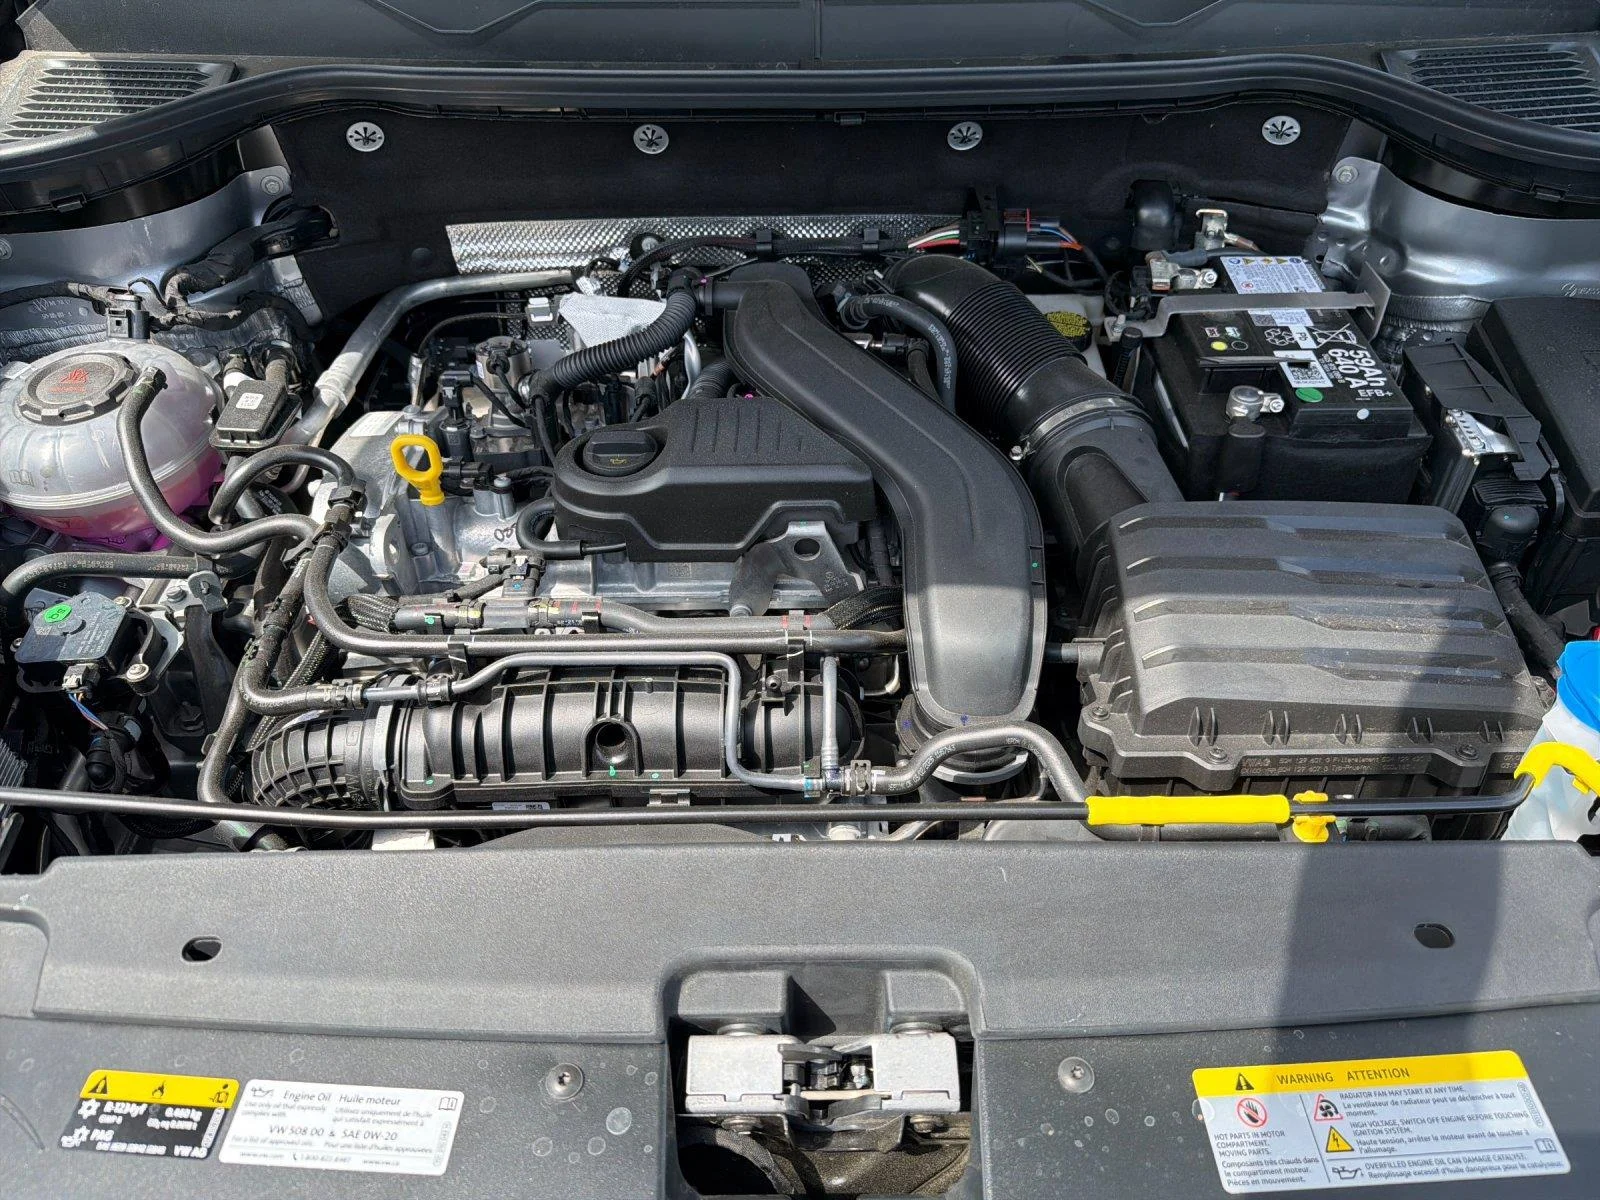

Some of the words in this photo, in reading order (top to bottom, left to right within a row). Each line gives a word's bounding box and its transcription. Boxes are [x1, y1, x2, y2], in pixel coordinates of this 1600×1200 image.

[1328, 348, 1360, 374] 640
[1344, 376, 1369, 388] A
[1349, 350, 1387, 386] 59Ah
[1358, 389, 1393, 397] EFB+
[1276, 1072, 1334, 1085] WARNING
[1346, 1068, 1410, 1081] ATTENTION
[283, 1090, 316, 1102] Engine
[317, 1092, 332, 1101] Oil
[339, 1093, 364, 1103] Huile
[366, 1095, 401, 1106] moteur
[1339, 1091, 1373, 1100] RADIATOR
[1373, 1090, 1387, 1098] FAN
[1388, 1089, 1402, 1097] MAY
[1403, 1088, 1423, 1096] START
[1433, 1086, 1447, 1094] ANY
[1352, 1100, 1389, 1108] ventilateur
[1400, 1097, 1431, 1105] radiateur
[1432, 1096, 1448, 1105] peut
[1457, 1093, 1494, 1101] déclencher
[1346, 1109, 1377, 1117] moment.
[1350, 1120, 1367, 1129] HIGH
[1368, 1119, 1400, 1128] VOLTAGE,
[1401, 1117, 1426, 1125] SWITCH
[1427, 1116, 1440, 1124] OFF
[1441, 1114, 1467, 1122] ENGINE
[1467, 1113, 1494, 1121] BEFORE
[1494, 1111, 1529, 1119] TOUCHING
[269, 1124, 288, 1134] VW
[289, 1126, 308, 1136] 508
[310, 1127, 325, 1137] 00
[329, 1129, 336, 1137] &
[342, 1128, 363, 1140] SAE
[363, 1130, 399, 1141] 0W-20
[1214, 1133, 1228, 1141] HOT
[1229, 1132, 1250, 1140] PARTS
[1261, 1130, 1286, 1138] MOTOR
[1352, 1128, 1384, 1137] IGNITION
[1384, 1126, 1412, 1135] SYSTEM.
[1356, 1138, 1379, 1146] Haute
[1380, 1137, 1407, 1145] tension,
[1407, 1135, 1431, 1143] arrêter
[1439, 1133, 1465, 1141] moteur
[1466, 1131, 1485, 1139] avant
[1487, 1130, 1496, 1138] de
[1496, 1129, 1525, 1137] toucher
[1216, 1140, 1270, 1149] COMPARTMENT.
[1219, 1149, 1247, 1157] MOVING
[1248, 1148, 1271, 1156] PARTS.
[1222, 1160, 1264, 1169] Composants
[1264, 1158, 1278, 1166] très
[1278, 1156, 1302, 1164] chauds
[1303, 1156, 1320, 1164] dans
[1364, 1160, 1407, 1170] OVERFILLED
[1407, 1158, 1434, 1167] ENGINE
[1435, 1157, 1446, 1165] OIL
[1447, 1157, 1461, 1165] CAN
[1463, 1155, 1491, 1164] DAMAGE
[1232, 1168, 1283, 1178] compartiment
[1283, 1166, 1310, 1175] moteur.
[1368, 1170, 1410, 1180] Remplissage
[1413, 1168, 1440, 1176] excessif
[1465, 1164, 1501, 1173] dangereux
[1502, 1163, 1518, 1171] pour
[1227, 1178, 1250, 1187] Pièces
[1261, 1176, 1306, 1185] mouvement.
